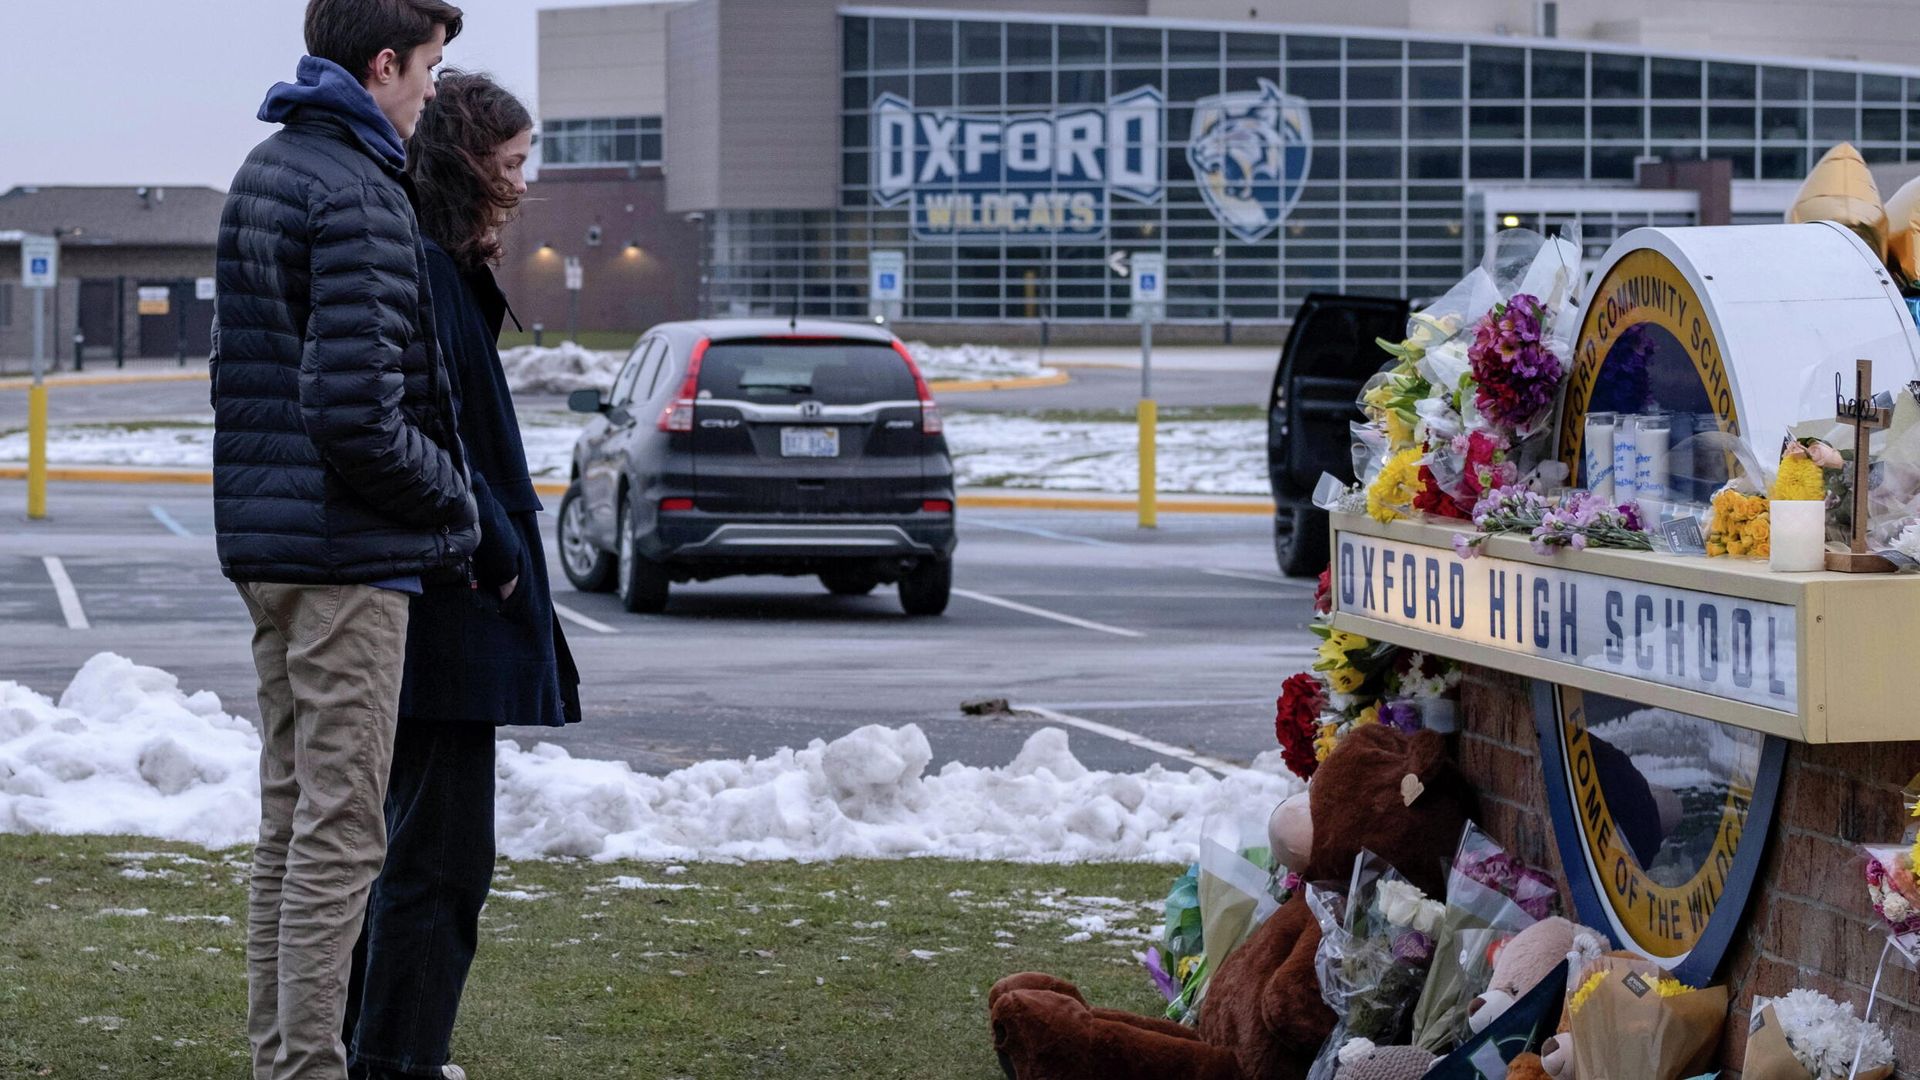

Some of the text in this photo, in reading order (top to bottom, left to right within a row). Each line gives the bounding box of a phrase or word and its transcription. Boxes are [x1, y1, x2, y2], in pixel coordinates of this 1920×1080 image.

[878, 90, 1161, 200] OXFORD
[923, 192, 1097, 233] WILDCATS
[1598, 274, 1688, 343] COMMUNITY
[1341, 542, 1786, 696] OXFORD HIGH SCHOOL
[1569, 706, 1612, 861] HOME
[1615, 856, 1640, 910] OF
[1646, 889, 1683, 941] THE
